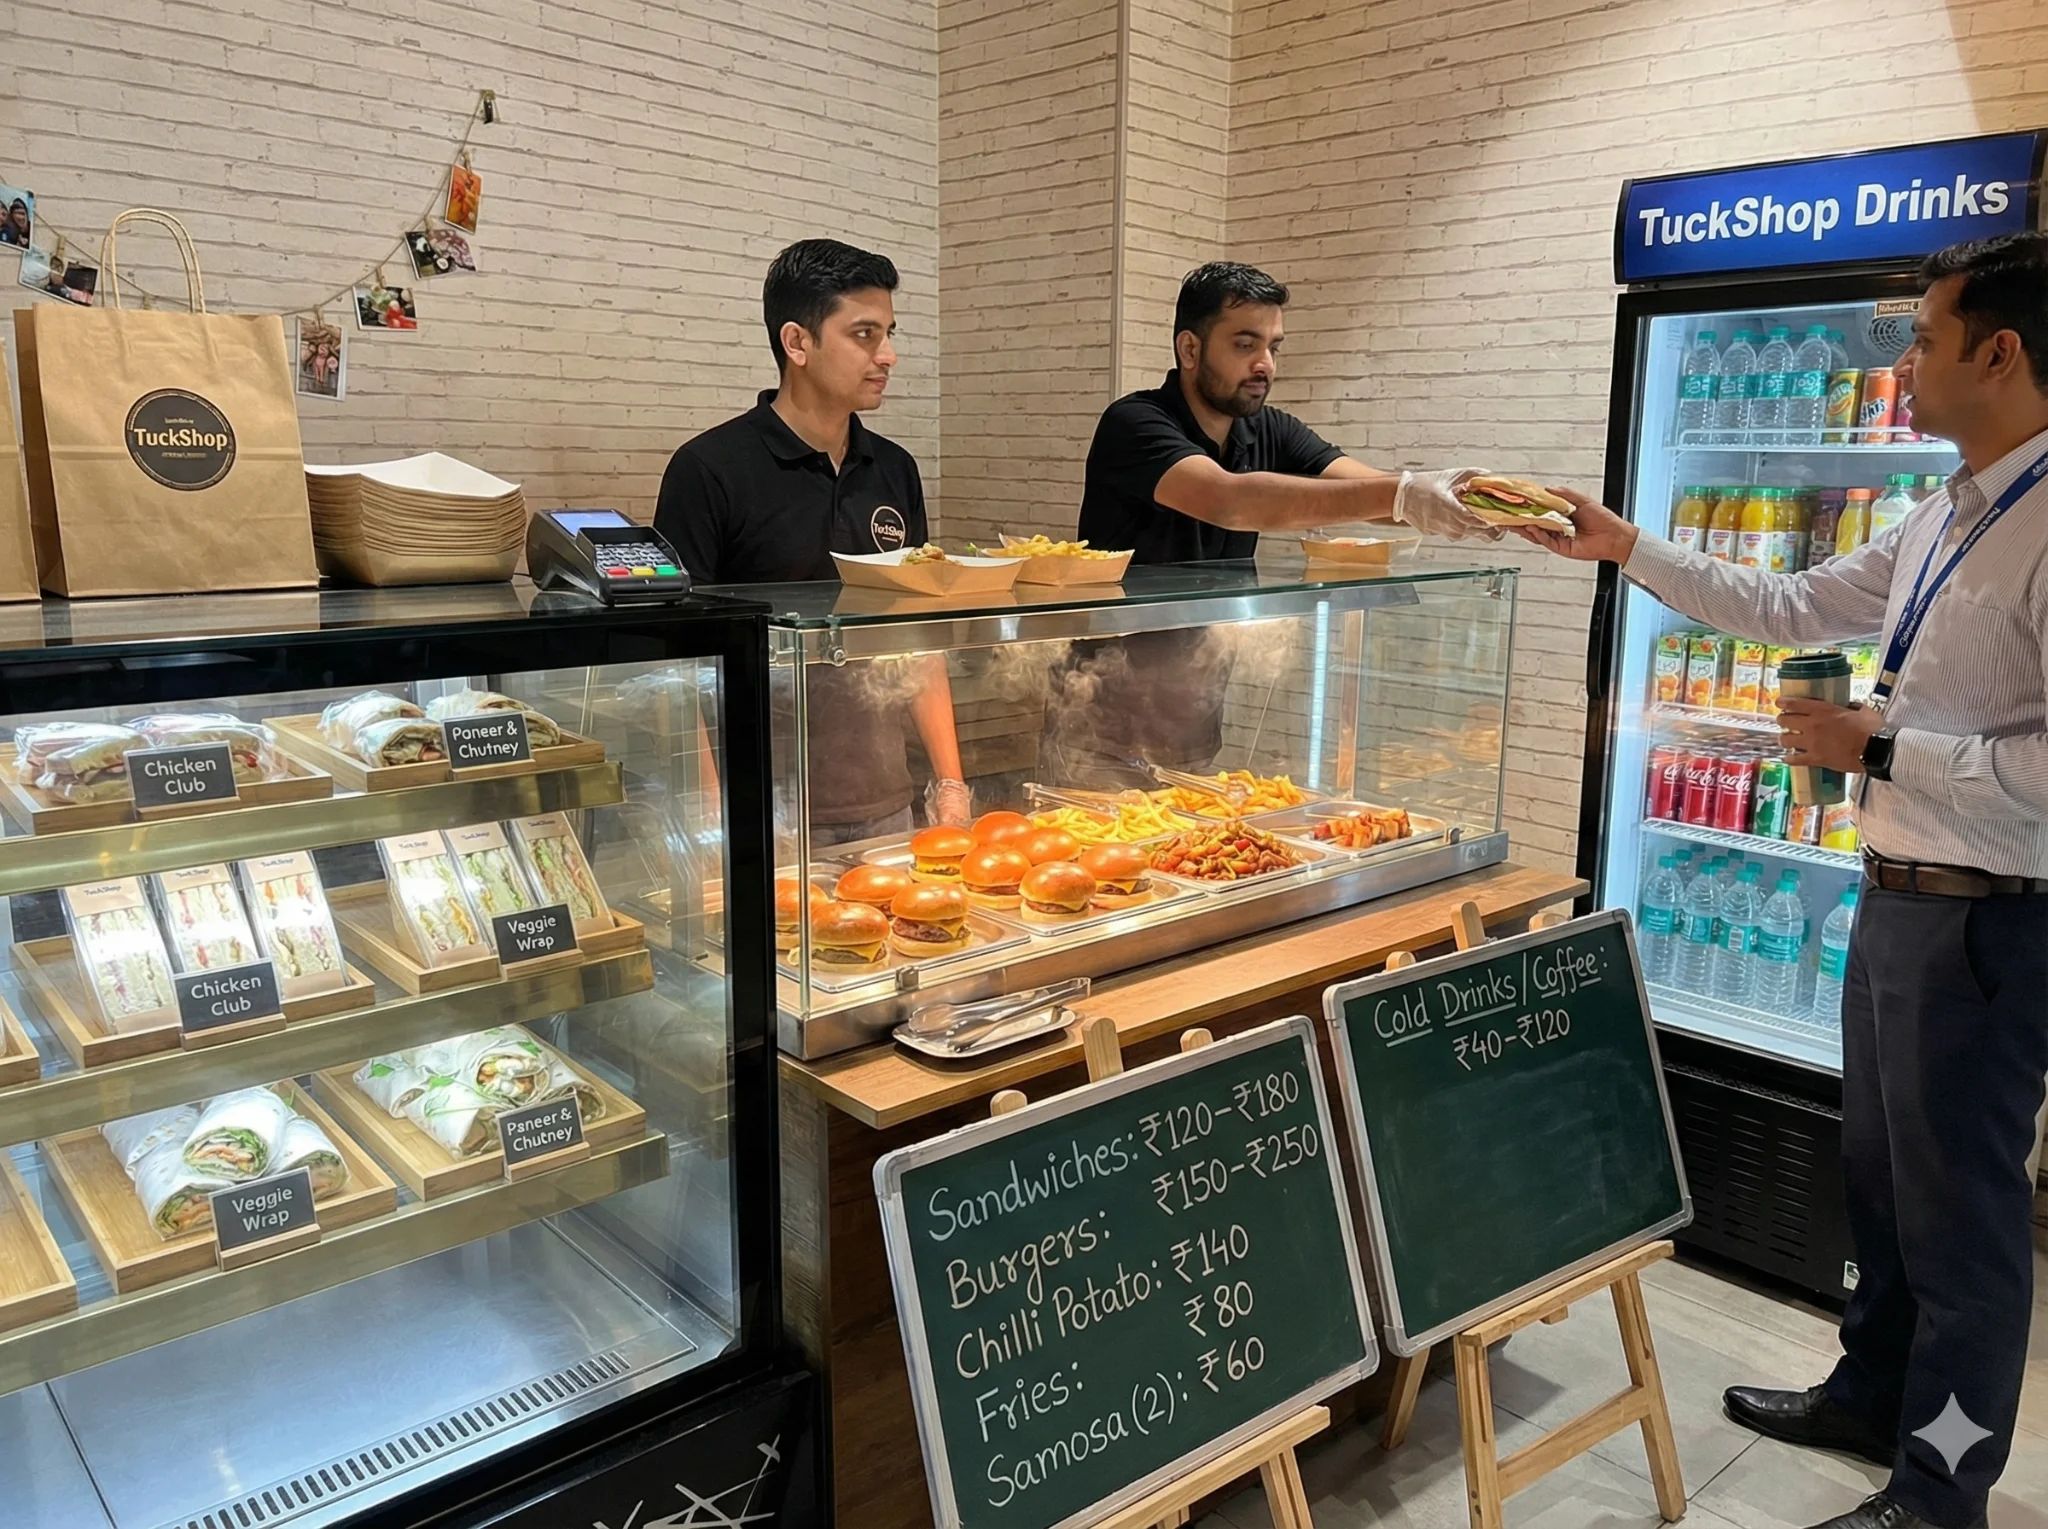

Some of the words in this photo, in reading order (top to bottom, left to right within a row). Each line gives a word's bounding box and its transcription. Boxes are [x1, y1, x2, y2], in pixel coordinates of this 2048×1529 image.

[1639, 195, 1840, 247] TuckShop
[1855, 174, 2009, 227] Drinks
[133, 428, 228, 451] TuckShop
[507, 720, 518, 736] &
[458, 741, 519, 758] Chutney
[144, 757, 217, 776] Chicken
[165, 776, 206, 795] Club
[507, 915, 557, 935] Veggie
[516, 936, 555, 952] Wrap
[191, 977, 262, 999] Chicken
[211, 996, 252, 1016] Club
[1374, 988, 1431, 1039] Cold
[561, 1107, 573, 1121] &
[513, 1126, 573, 1152] Chutney
[927, 1131, 1140, 1242] Sandwiches:
[232, 1187, 293, 1214] Veggie
[243, 1210, 290, 1232] Wrap
[945, 1210, 1112, 1310] Burgers:
[955, 1308, 1043, 1379] Chilli
[1052, 1259, 1162, 1337] Potato:
[1169, 1223, 1250, 1284] ₹140
[975, 1361, 1084, 1443] Fries:
